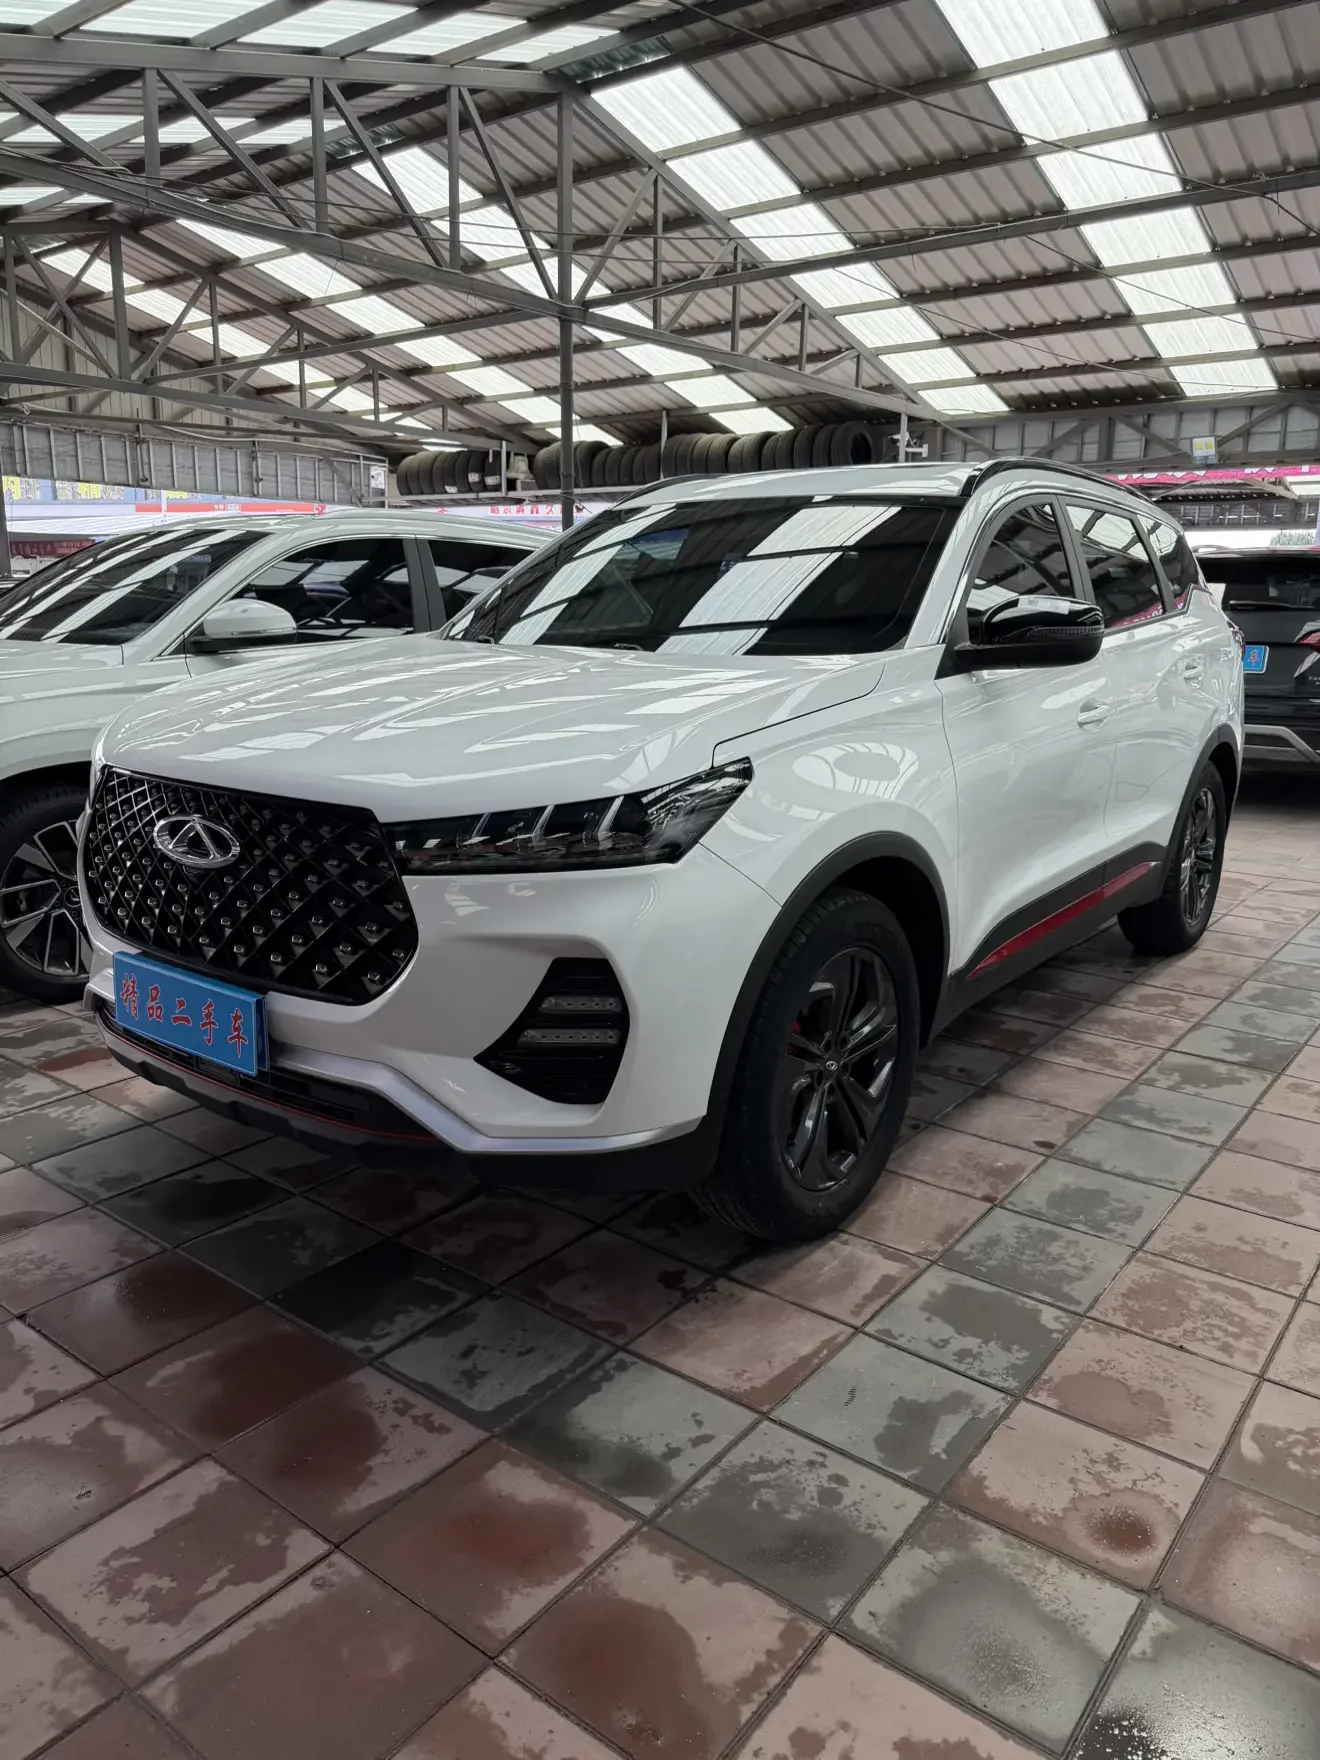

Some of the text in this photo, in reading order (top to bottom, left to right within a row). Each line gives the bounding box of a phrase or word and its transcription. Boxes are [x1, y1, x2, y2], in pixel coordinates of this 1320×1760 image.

[119, 972, 249, 1059] 精品二手车
